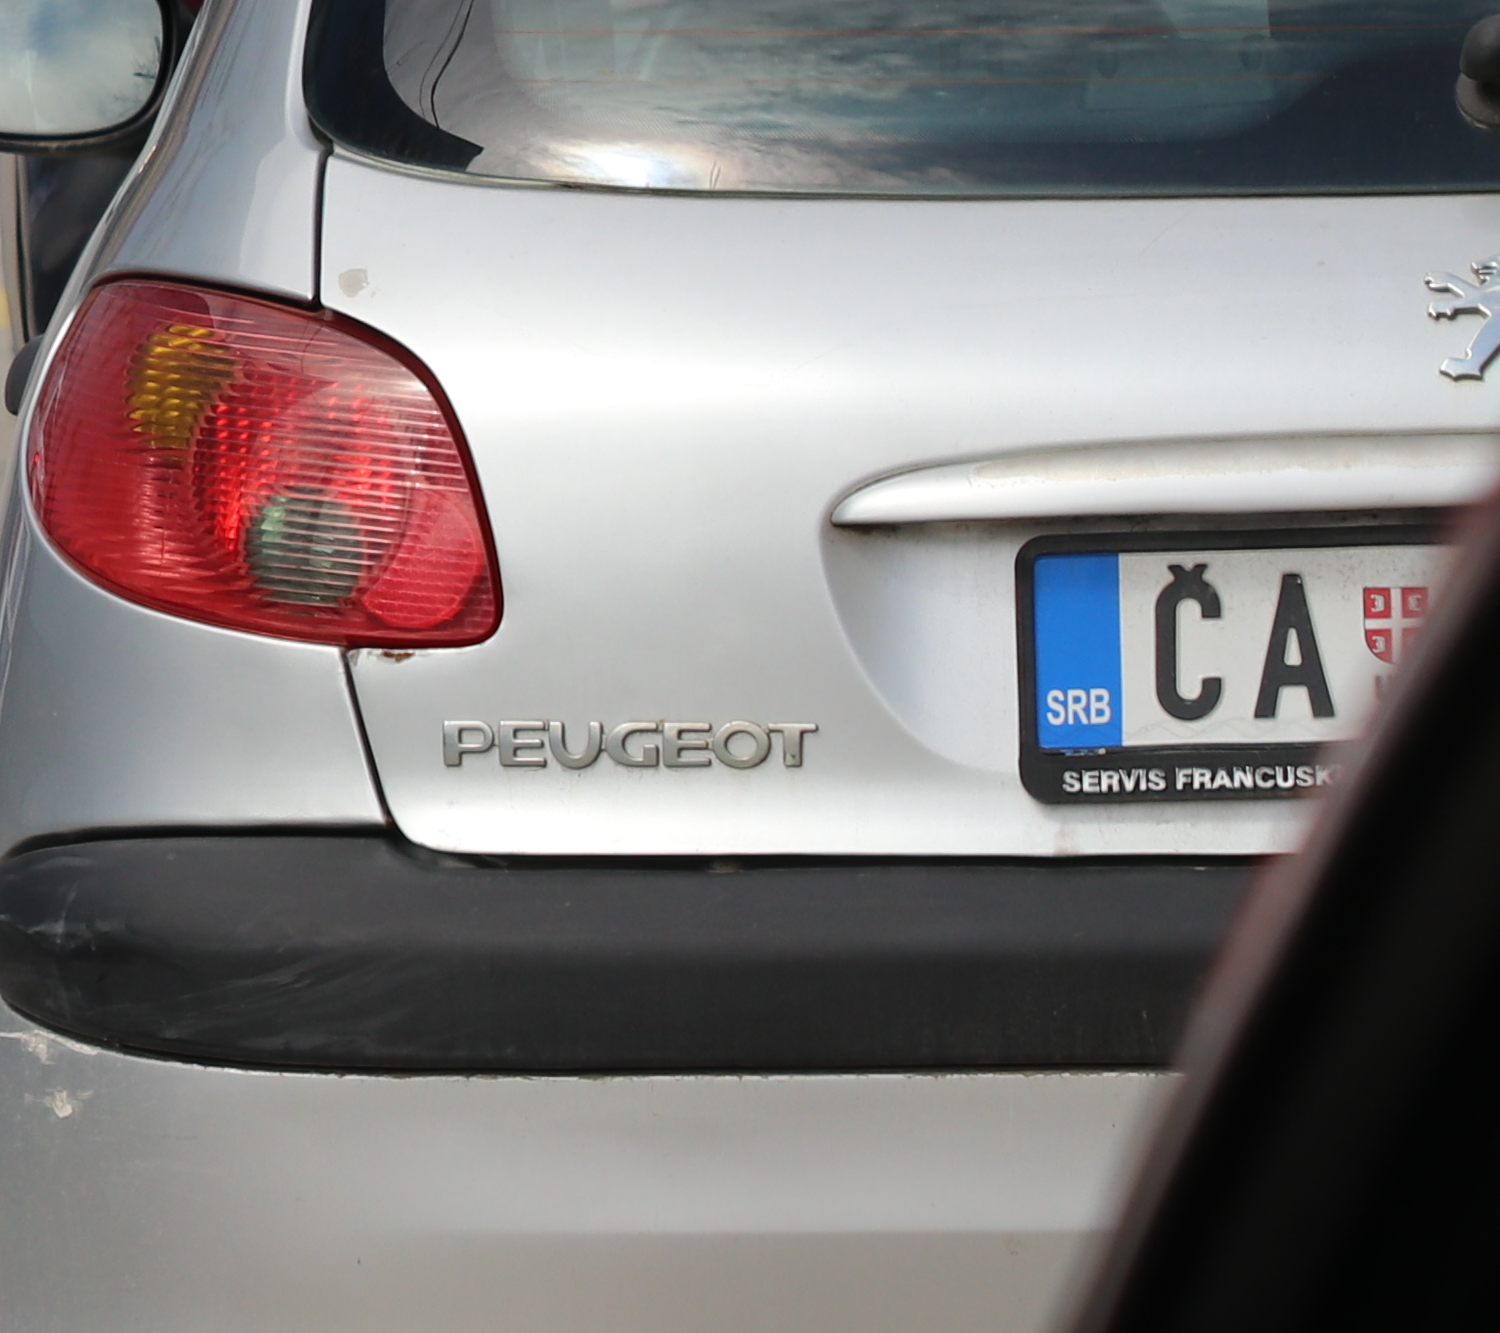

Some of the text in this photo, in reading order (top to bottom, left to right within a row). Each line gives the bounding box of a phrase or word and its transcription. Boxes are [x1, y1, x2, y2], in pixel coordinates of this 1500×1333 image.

[1154, 563, 1336, 722] ČA
[1045, 686, 1112, 726] SRB
[442, 719, 819, 770] PEUGEOT
[1061, 763, 1340, 795] SERVIS FRANCUSK
